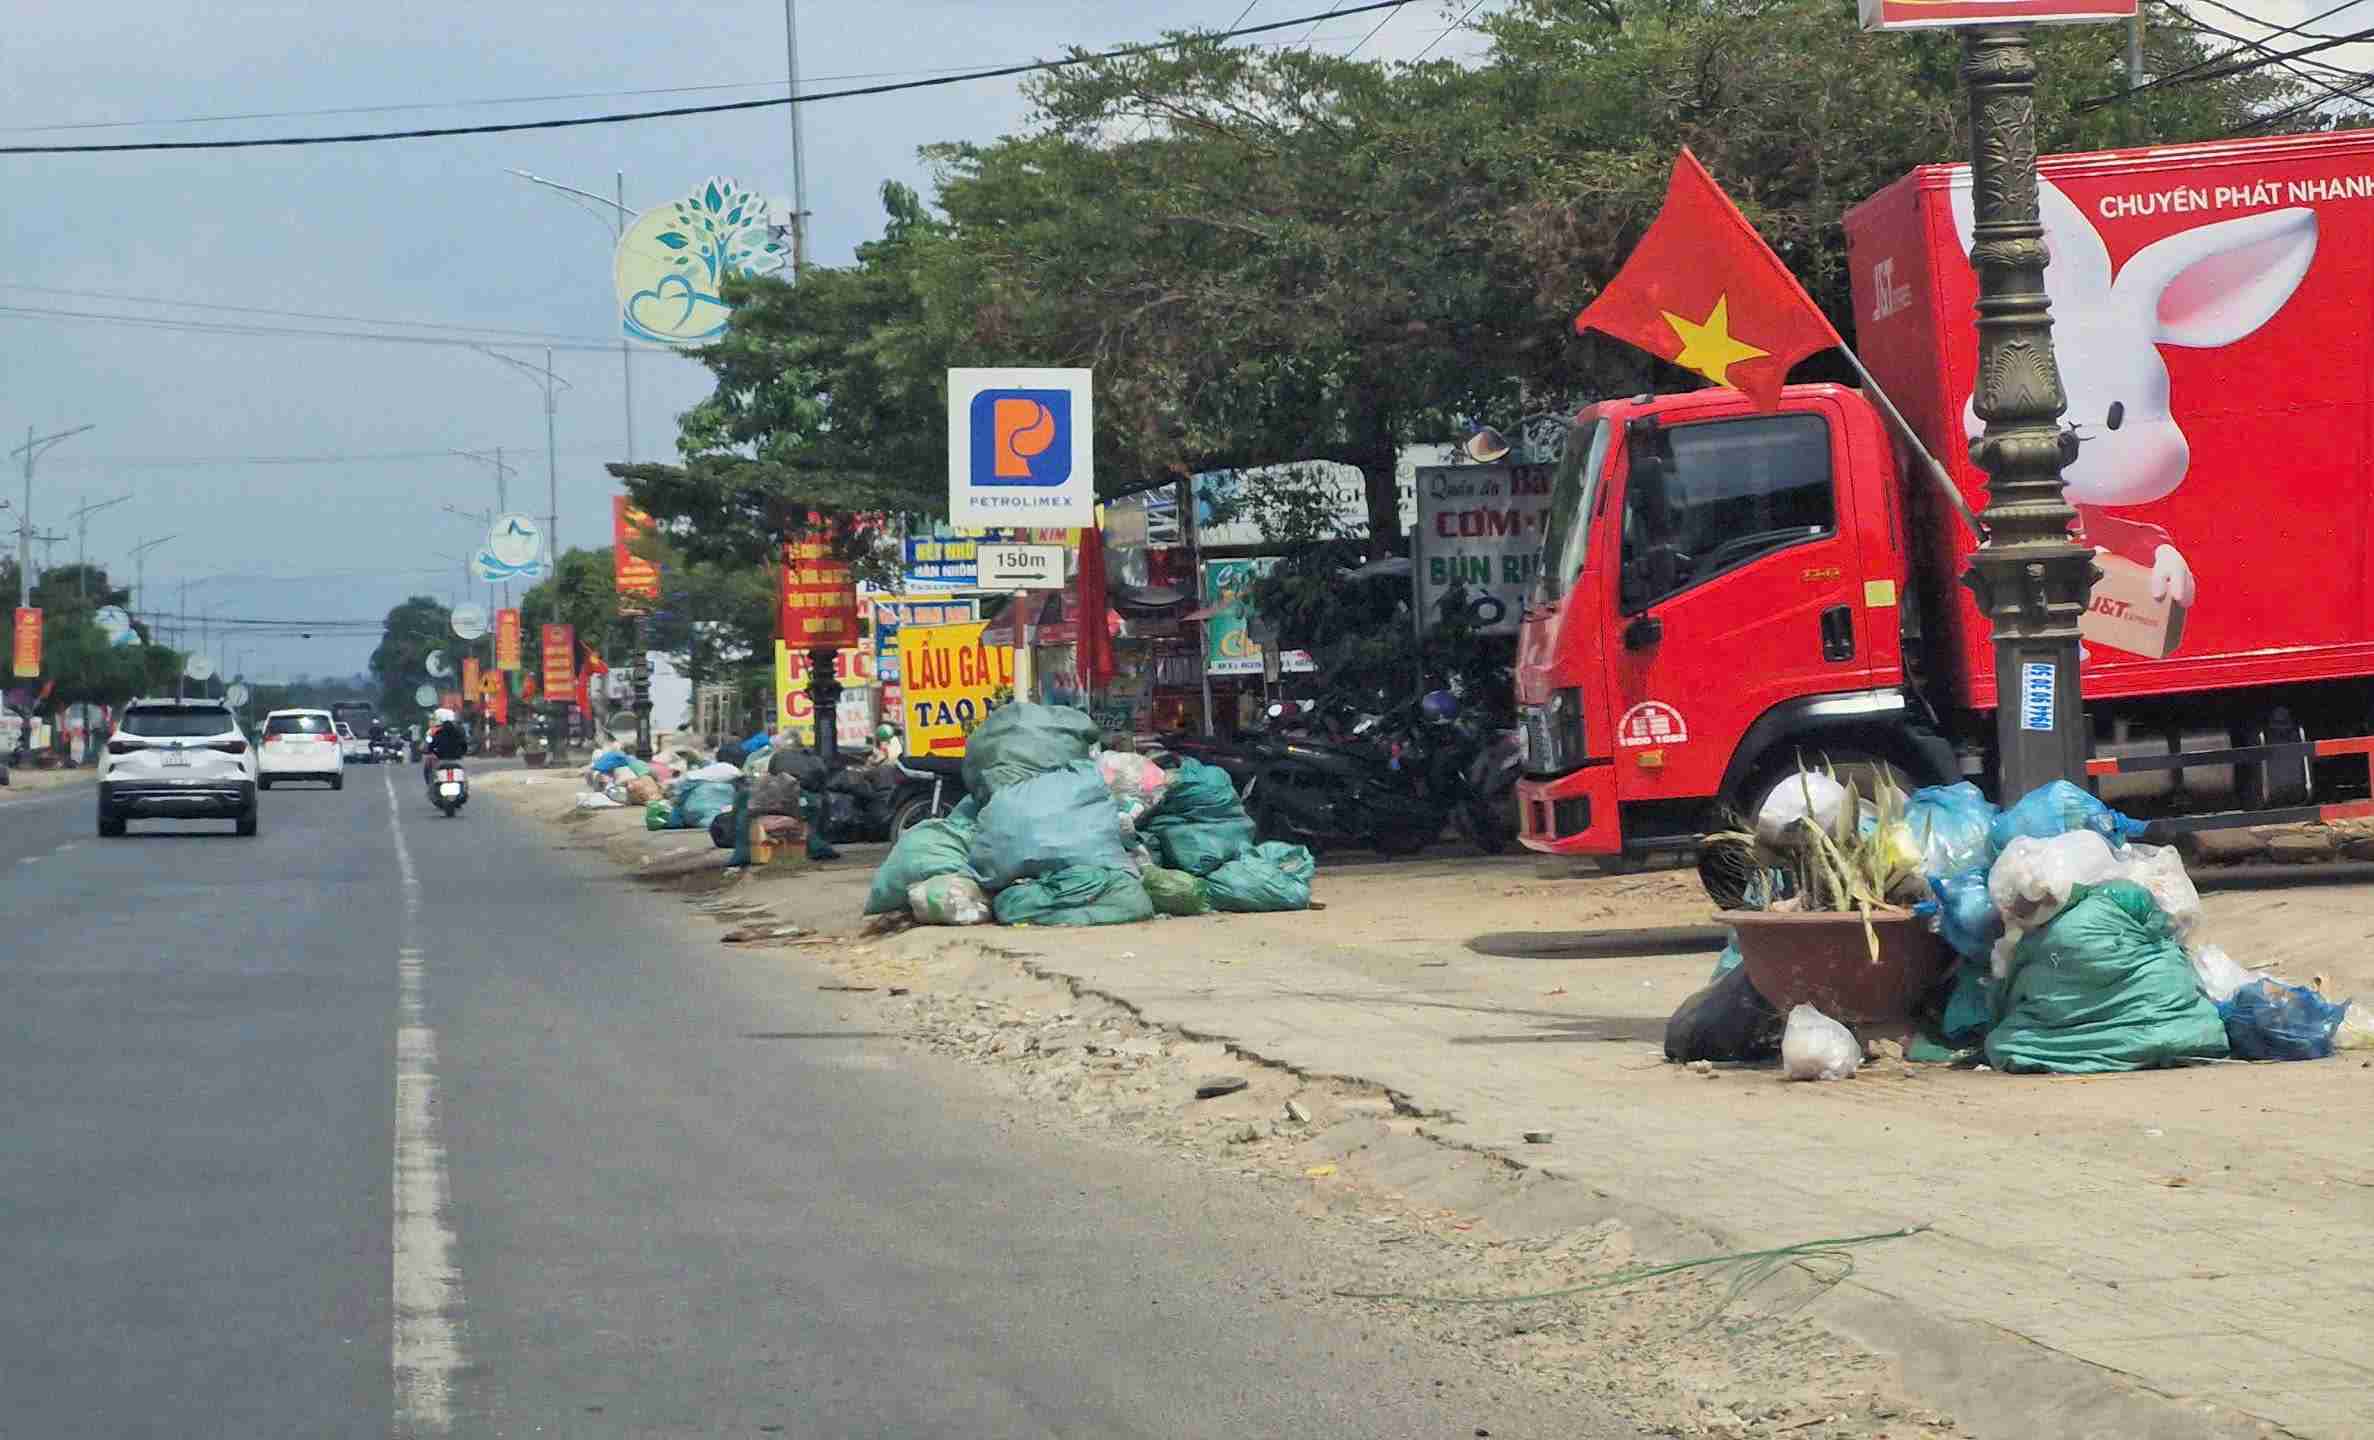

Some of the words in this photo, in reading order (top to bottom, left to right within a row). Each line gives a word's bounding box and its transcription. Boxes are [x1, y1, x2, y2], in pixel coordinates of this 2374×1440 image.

[2214, 179, 2283, 209] PHÁT
[969, 496, 1073, 508] PETROLIMEX
[996, 552, 1047, 568] 150m
[1430, 548, 1491, 585] BÚN
